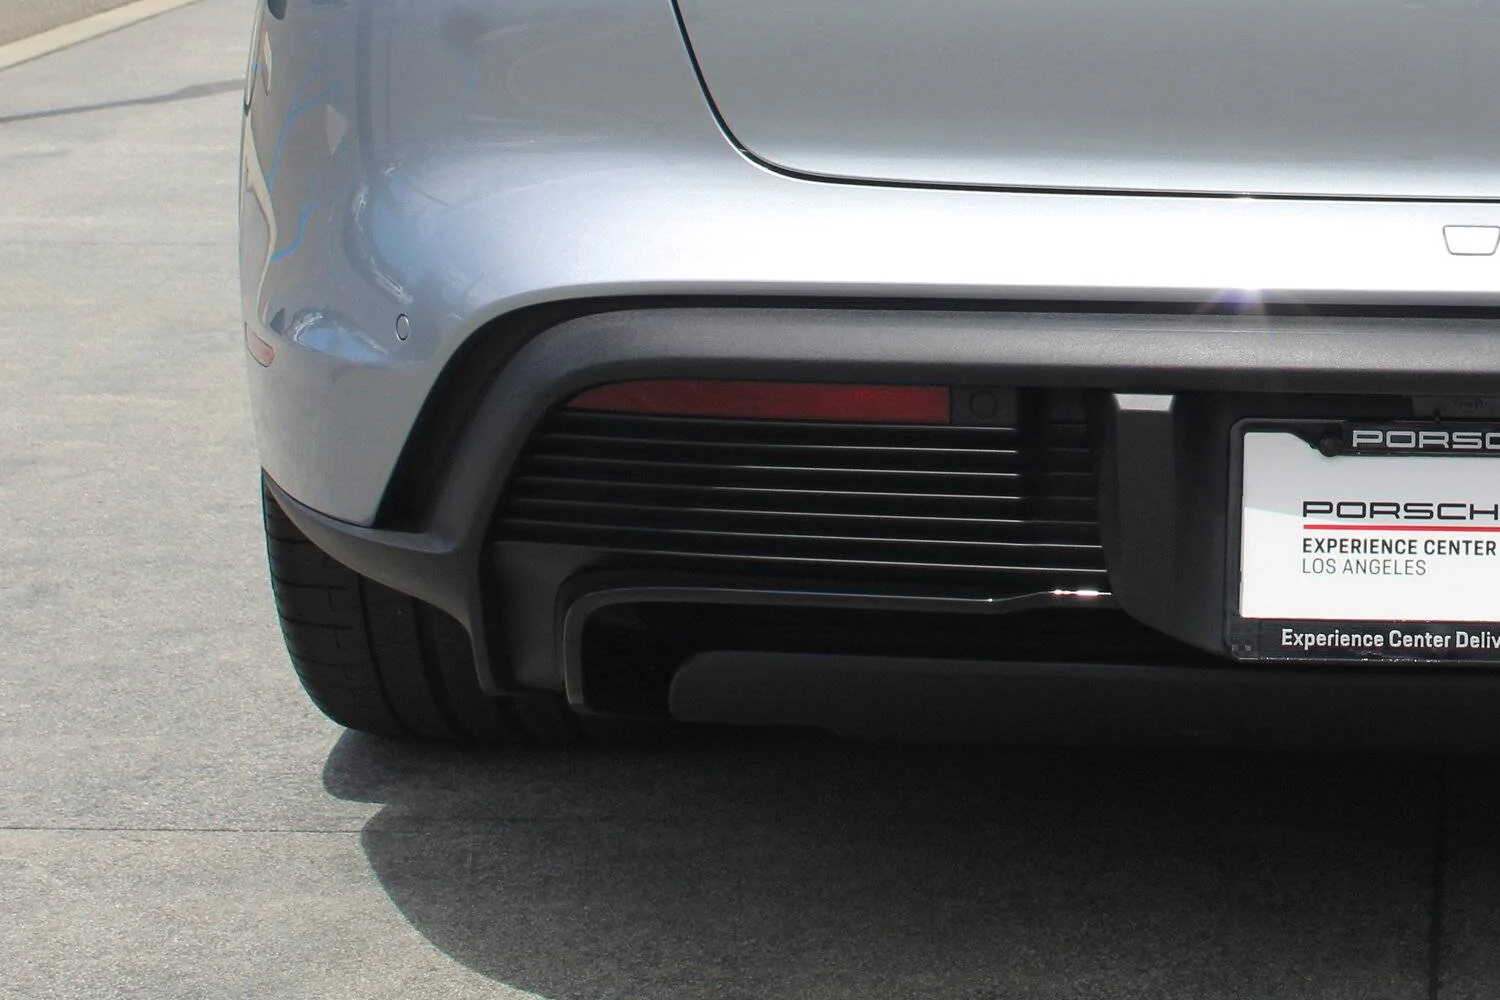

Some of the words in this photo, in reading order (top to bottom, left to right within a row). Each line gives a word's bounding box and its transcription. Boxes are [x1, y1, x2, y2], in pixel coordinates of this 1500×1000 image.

[1302, 538, 1418, 555] EXPERIENCE
[1424, 540, 1497, 556] CENTER
[1302, 558, 1337, 575] LOS
[1342, 559, 1427, 576] ANGELES
[1281, 628, 1384, 651] Experience
[1388, 630, 1452, 648] Center
